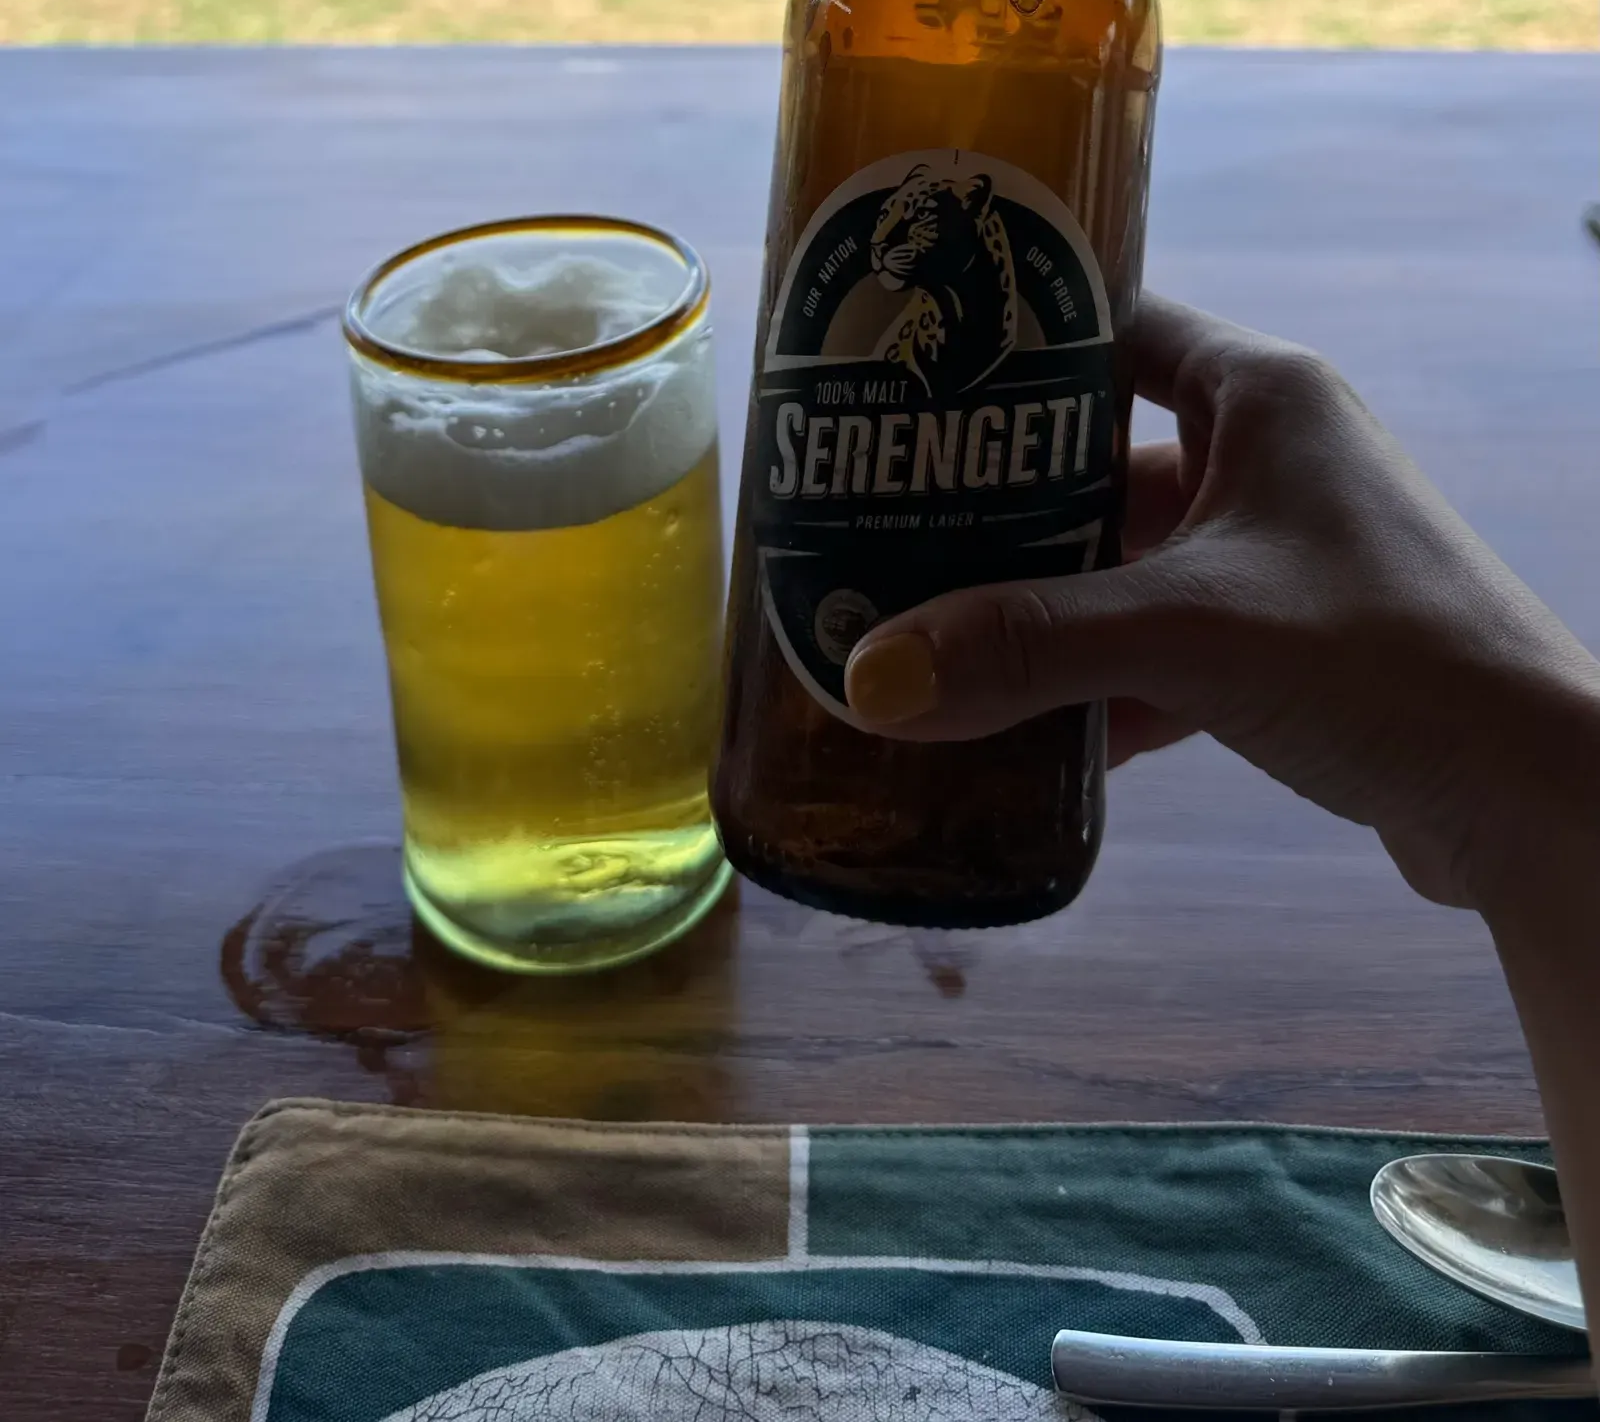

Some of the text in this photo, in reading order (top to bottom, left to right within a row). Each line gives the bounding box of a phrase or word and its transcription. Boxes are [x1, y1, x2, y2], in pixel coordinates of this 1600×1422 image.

[802, 236, 858, 318] OUR NATION
[1026, 245, 1077, 323] OUR PRIDE
[815, 379, 908, 406] 100% MALT
[769, 391, 1096, 501] SERENGETI
[855, 511, 974, 531] PREMIUM LAGER
